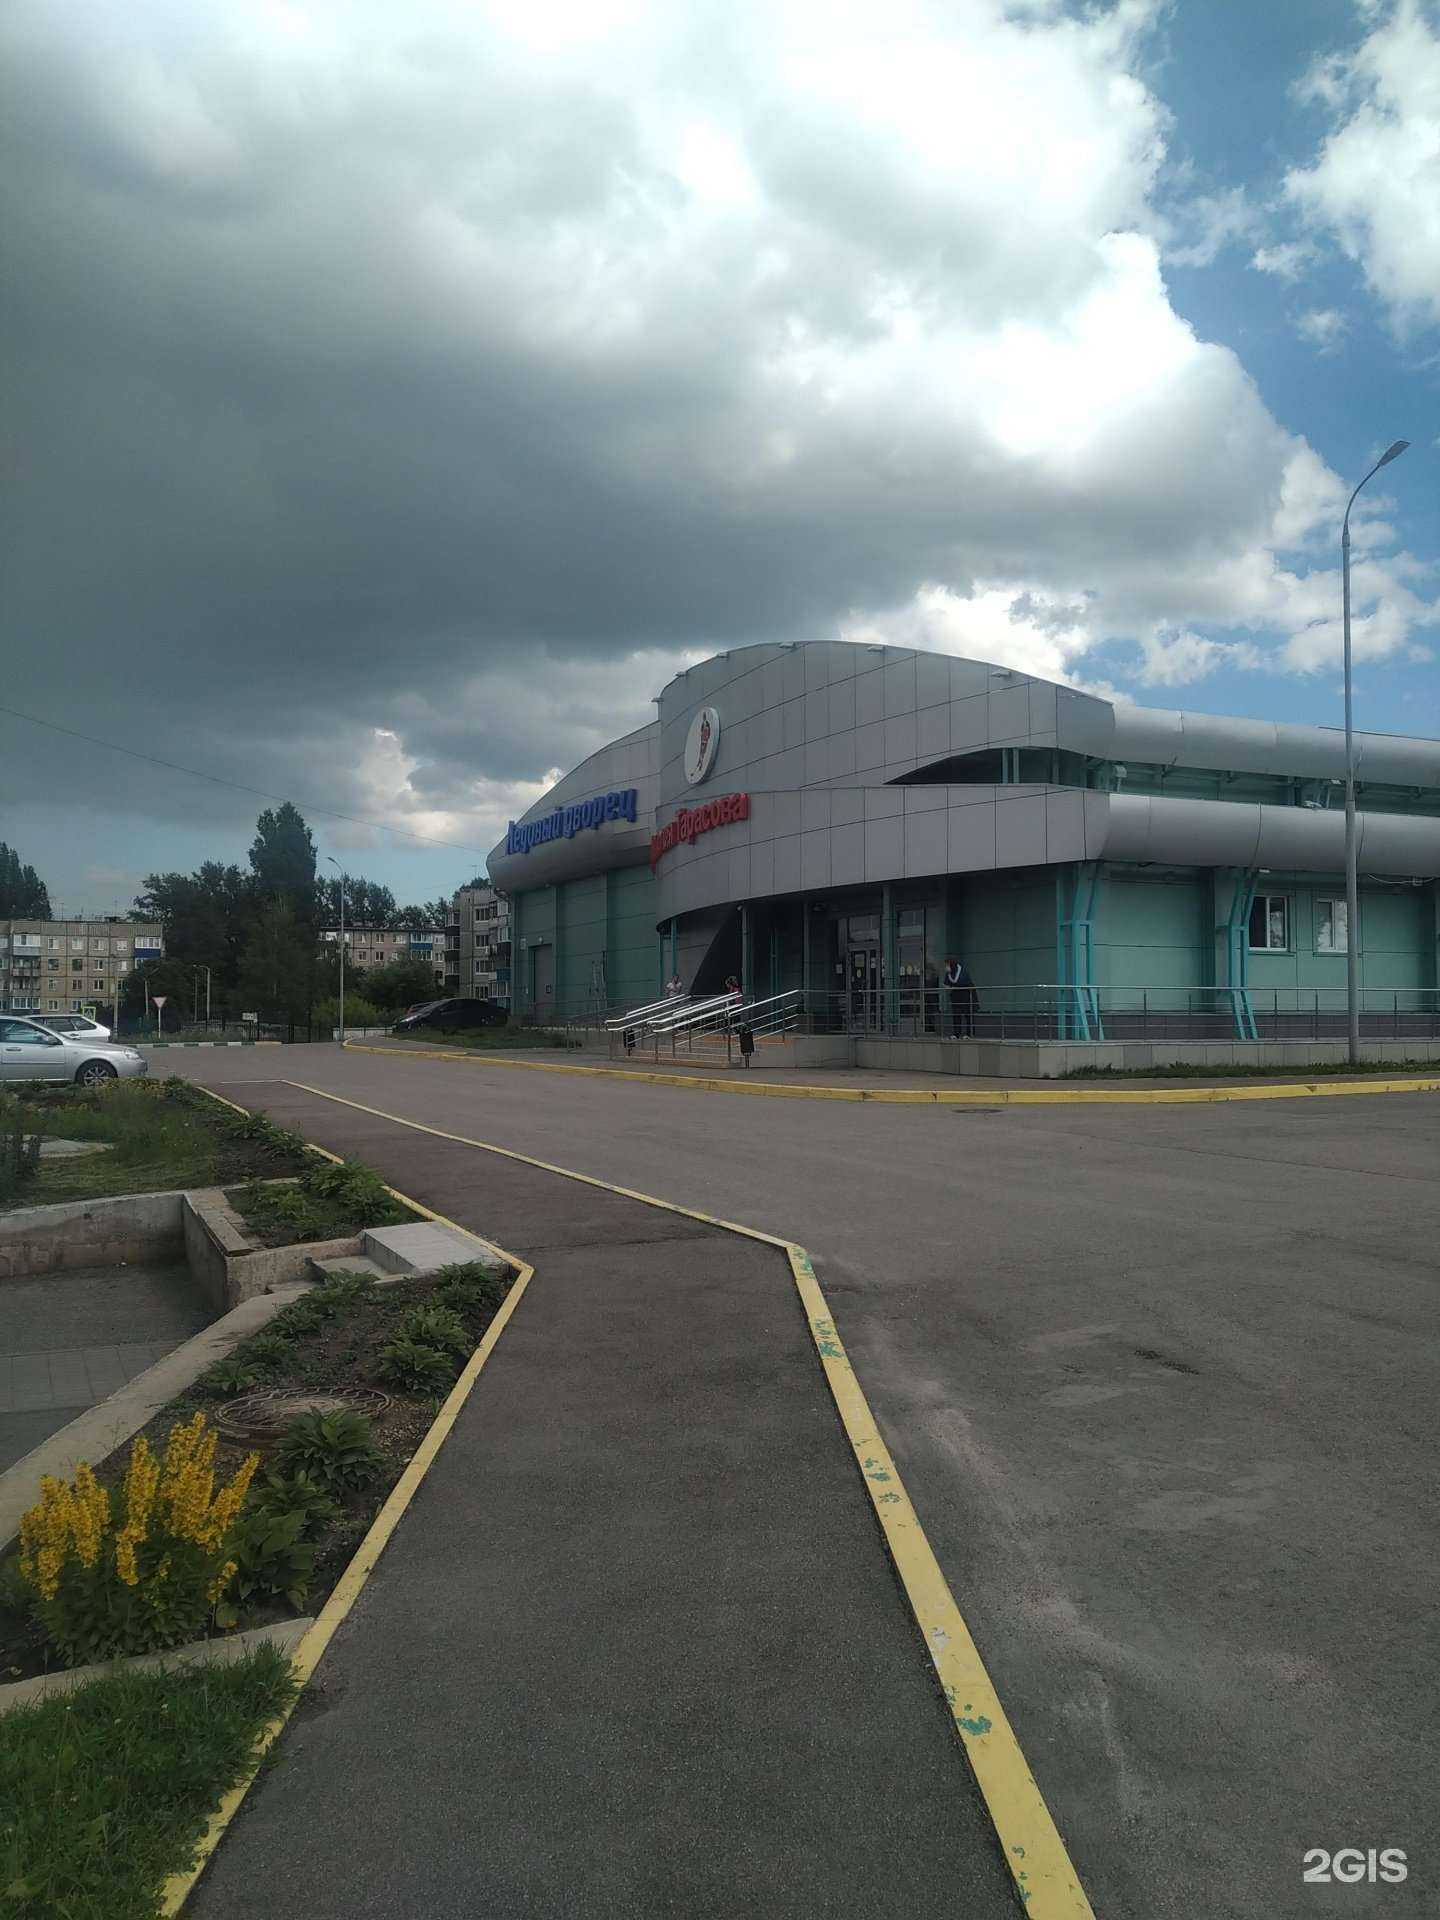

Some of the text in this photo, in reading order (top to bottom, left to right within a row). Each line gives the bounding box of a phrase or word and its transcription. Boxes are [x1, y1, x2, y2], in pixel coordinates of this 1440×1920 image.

[507, 789, 639, 855] Ледовый дворец
[671, 792, 749, 844] Тарасова
